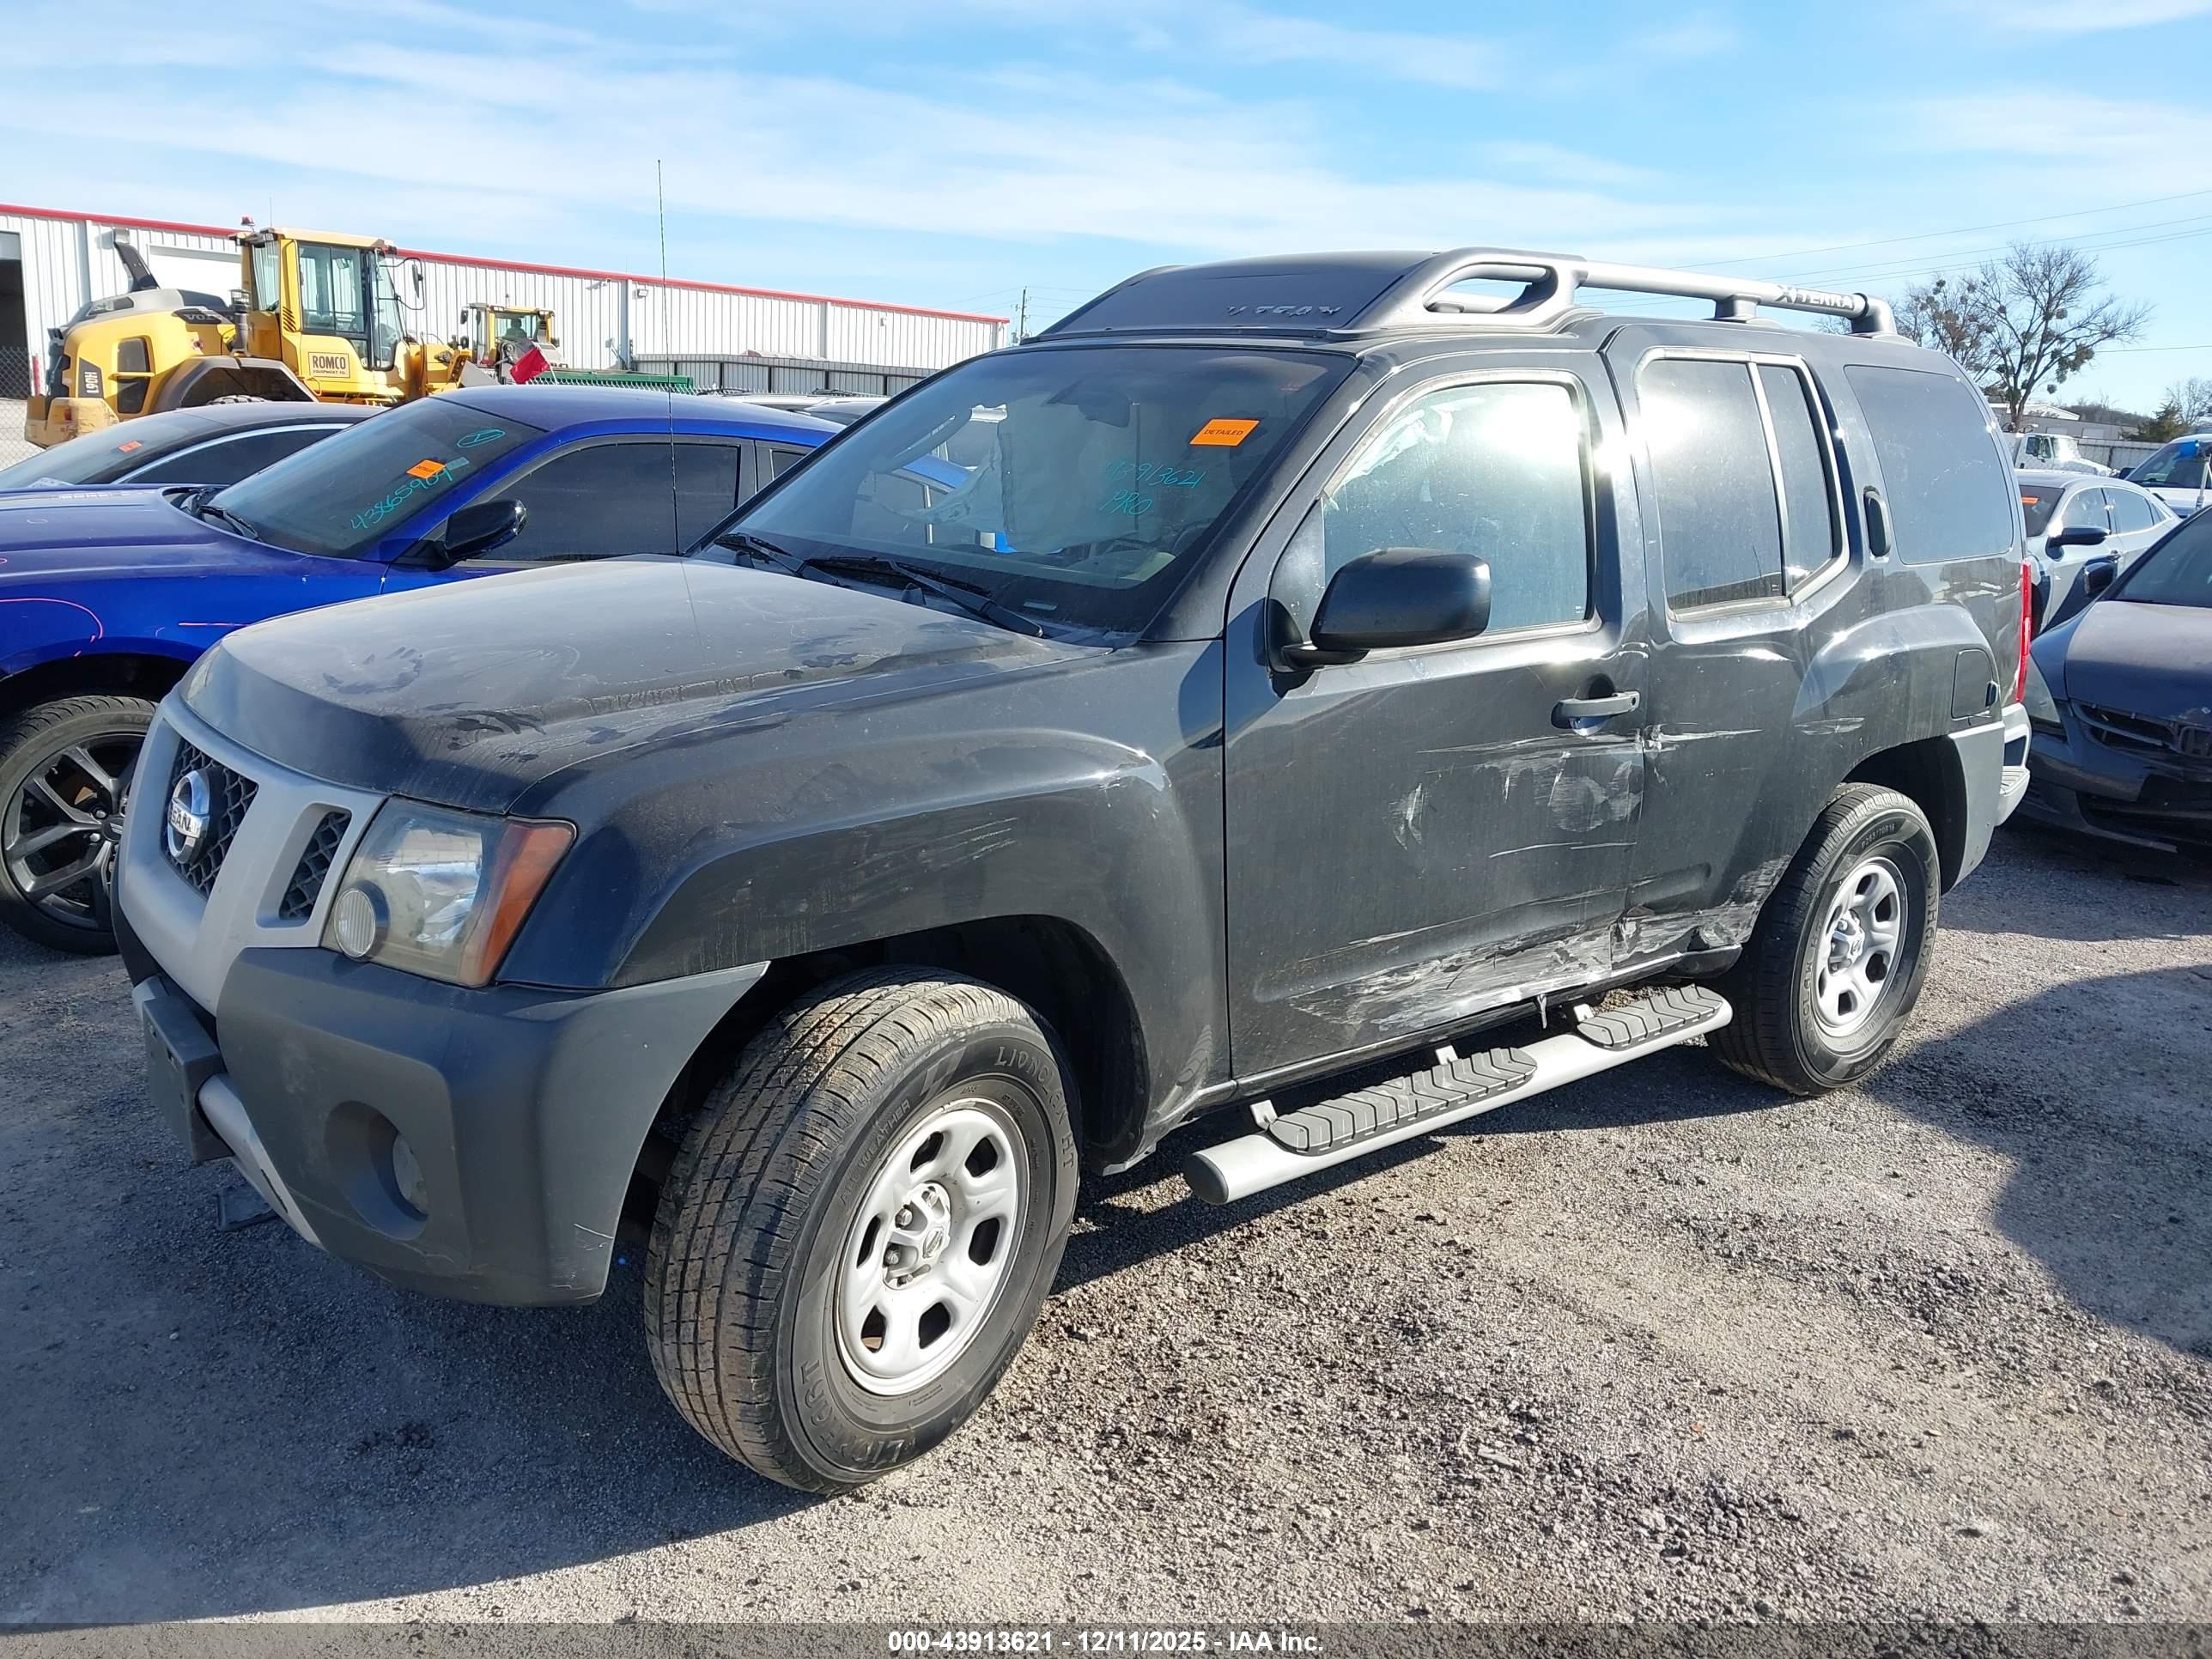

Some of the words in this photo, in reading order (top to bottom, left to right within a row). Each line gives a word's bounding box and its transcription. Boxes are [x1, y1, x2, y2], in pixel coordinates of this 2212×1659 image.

[1775, 284, 1855, 311] XTERRA
[313, 356, 346, 369] ROMCO
[84, 371, 100, 393] L90H
[1099, 489, 1153, 515] PRO
